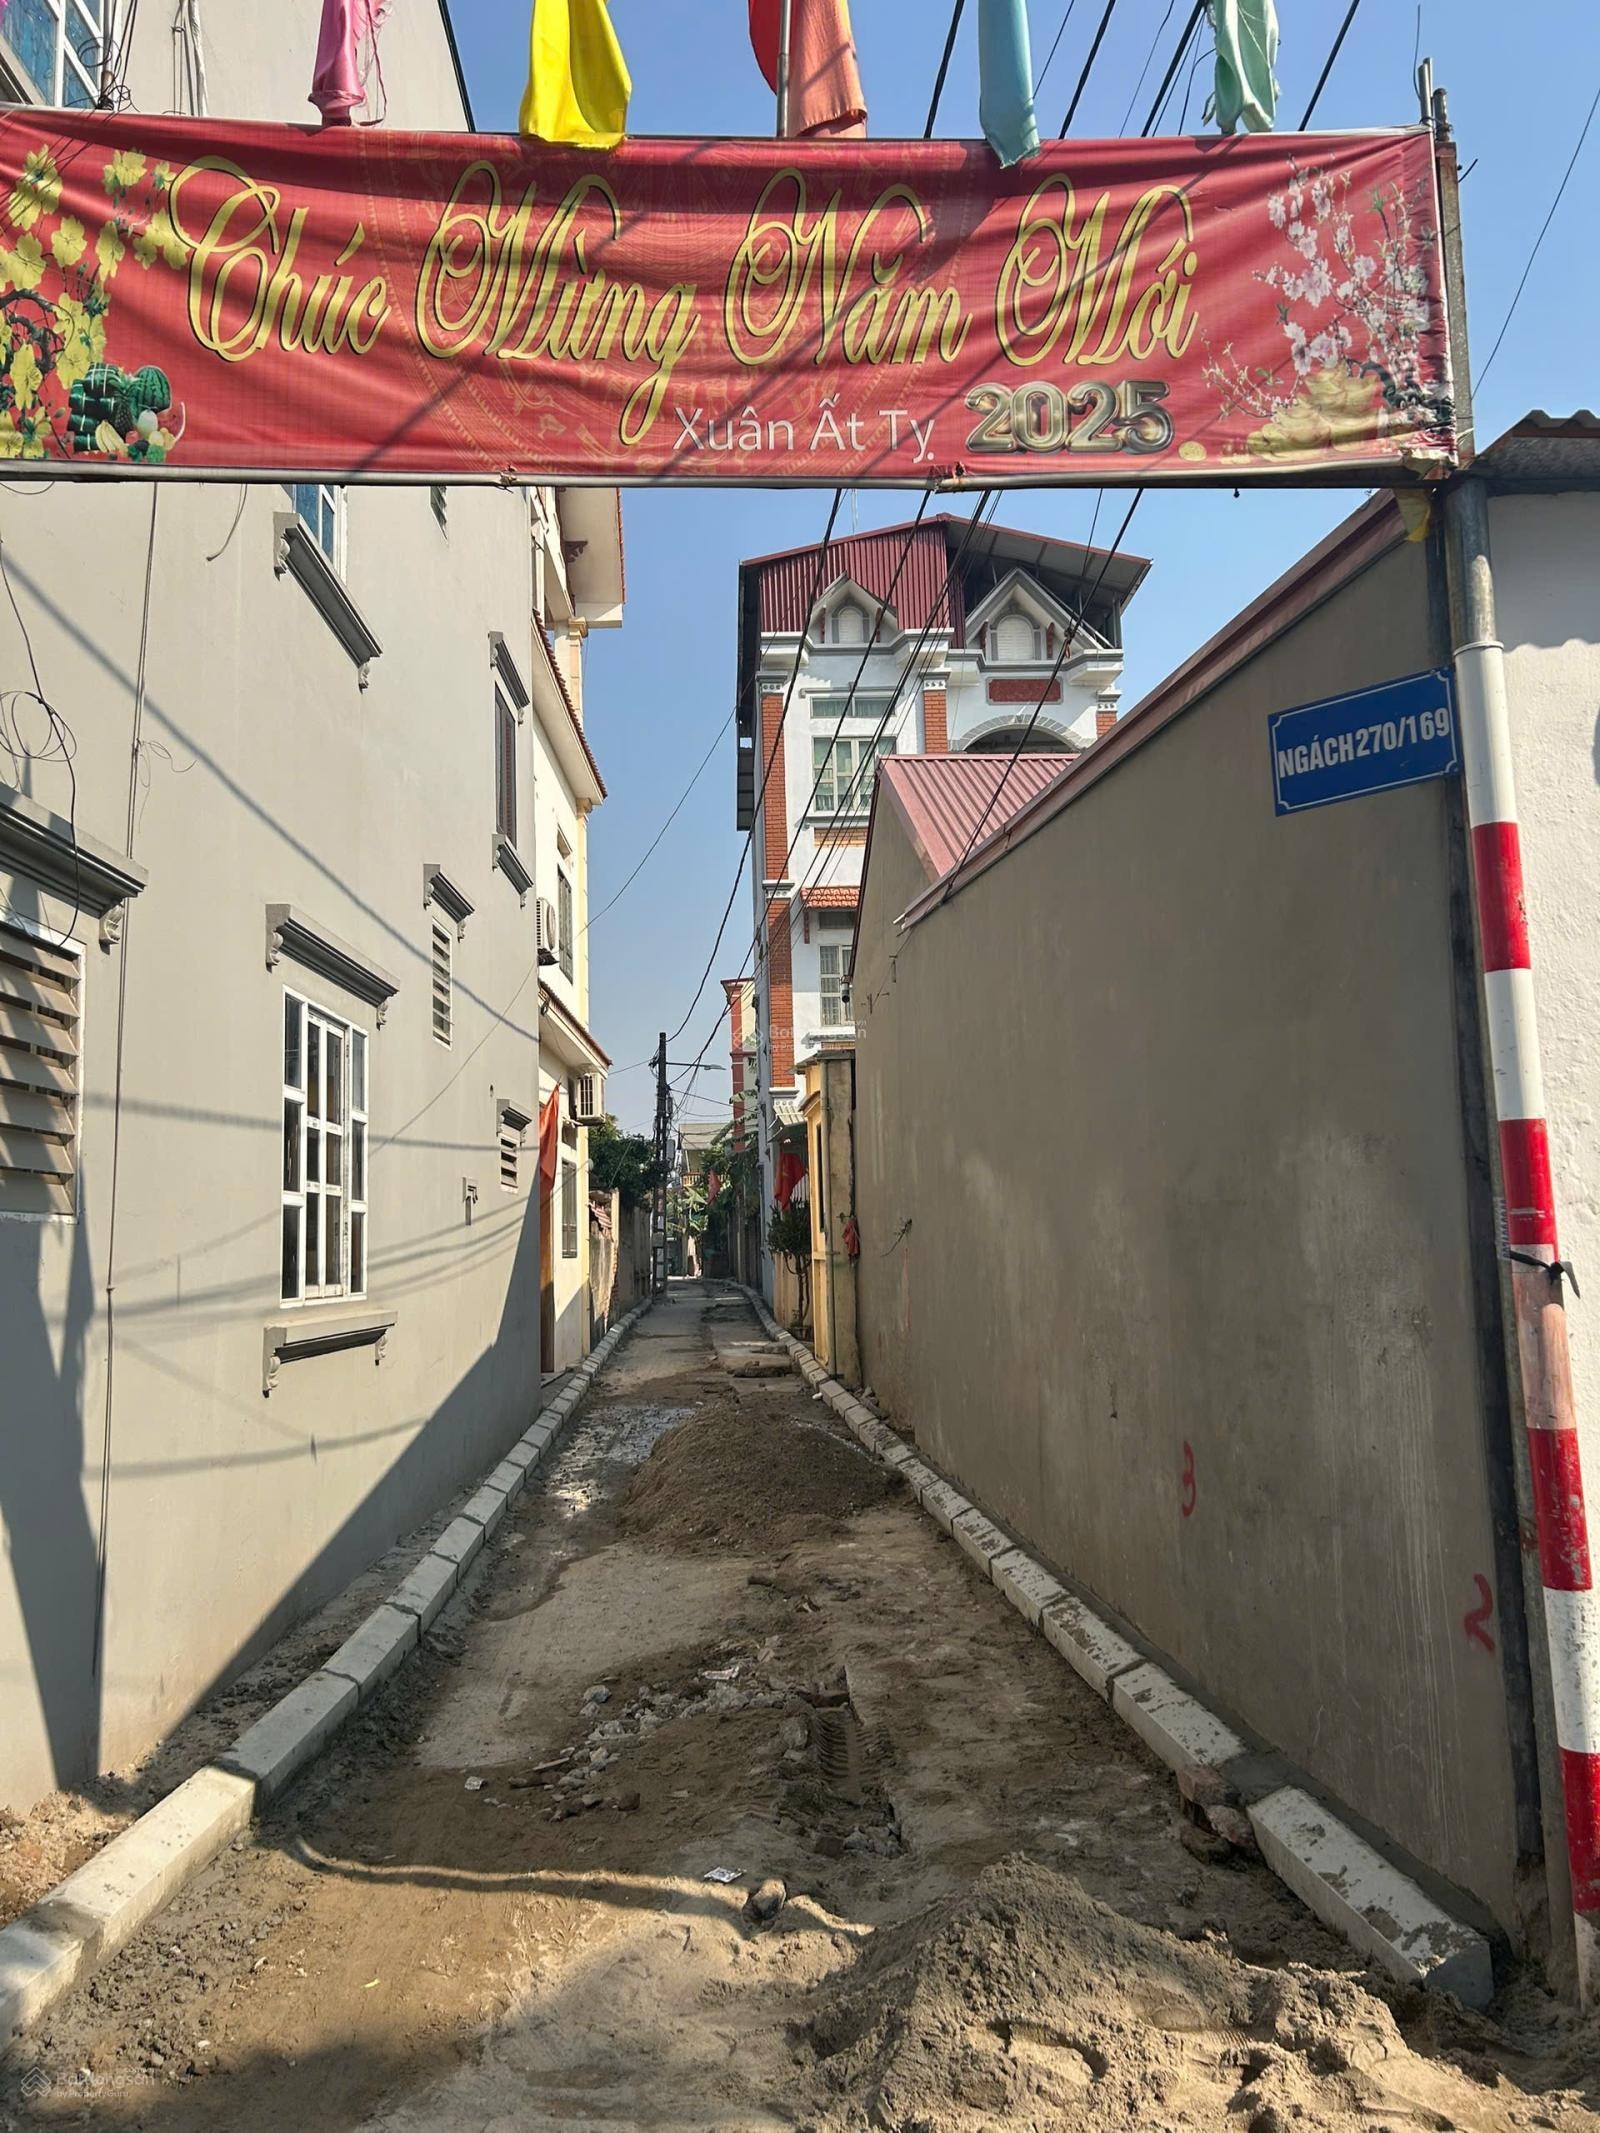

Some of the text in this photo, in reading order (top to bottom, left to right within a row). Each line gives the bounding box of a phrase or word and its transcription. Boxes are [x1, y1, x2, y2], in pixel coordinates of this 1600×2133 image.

[168, 155, 1199, 445] Chúc Mừng Năm Mới
[673, 393, 936, 463] Xuân Ất Tỵ
[964, 379, 1176, 455] 2025
